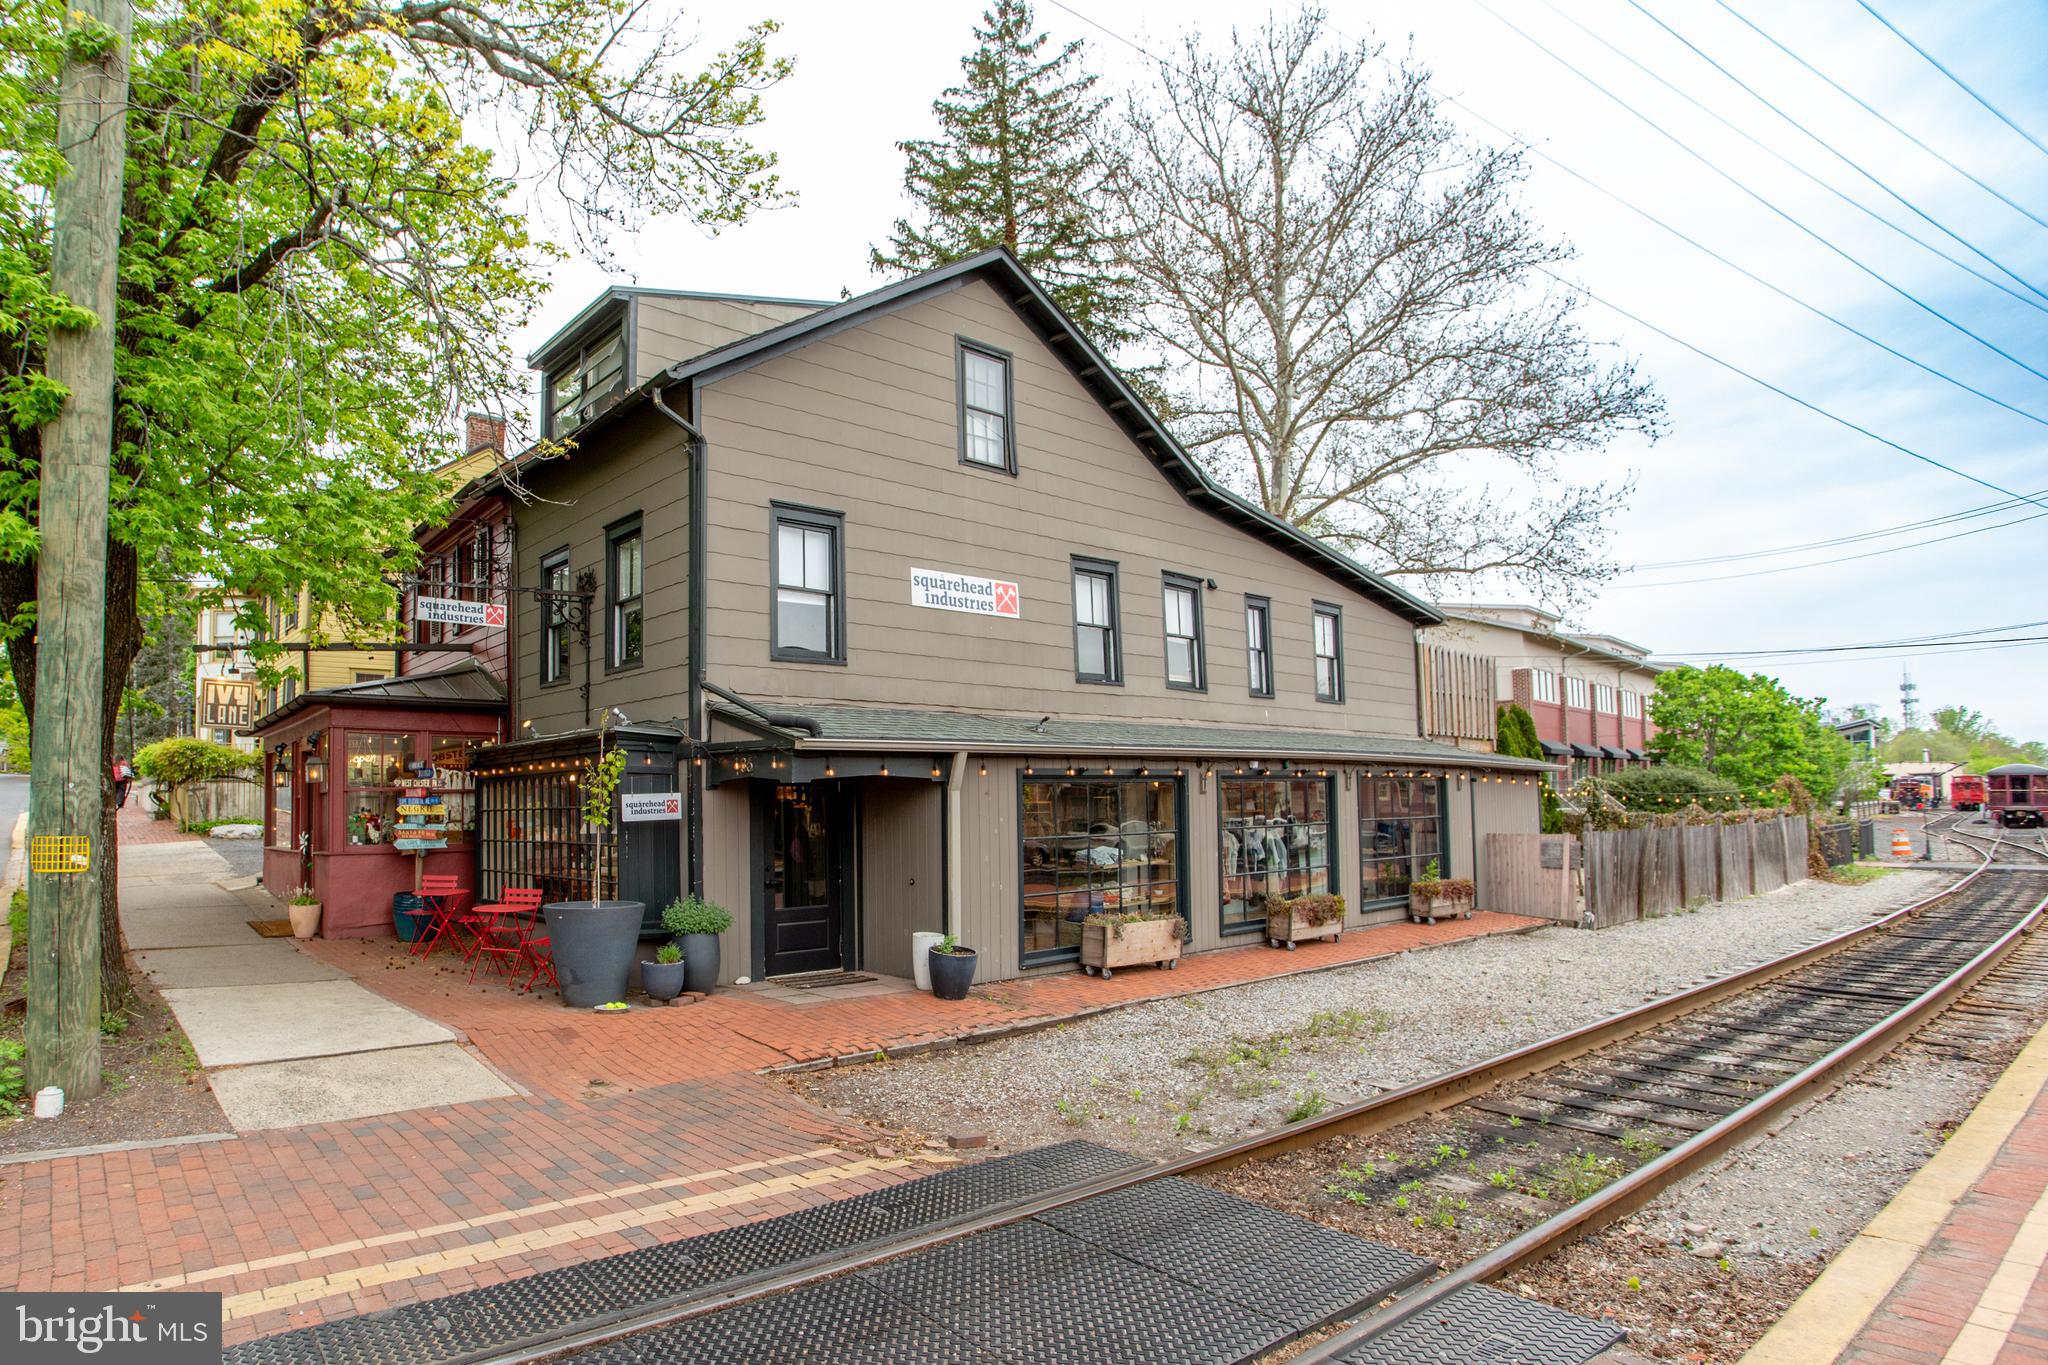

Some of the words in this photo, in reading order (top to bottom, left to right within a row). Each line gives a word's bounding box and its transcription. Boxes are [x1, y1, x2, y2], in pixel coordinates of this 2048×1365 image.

[925, 591, 994, 612] industries
[428, 611, 484, 624] industries
[207, 683, 249, 706] IVY
[206, 704, 248, 725] LANE
[351, 754, 376, 768] open
[631, 807, 666, 815] industries
